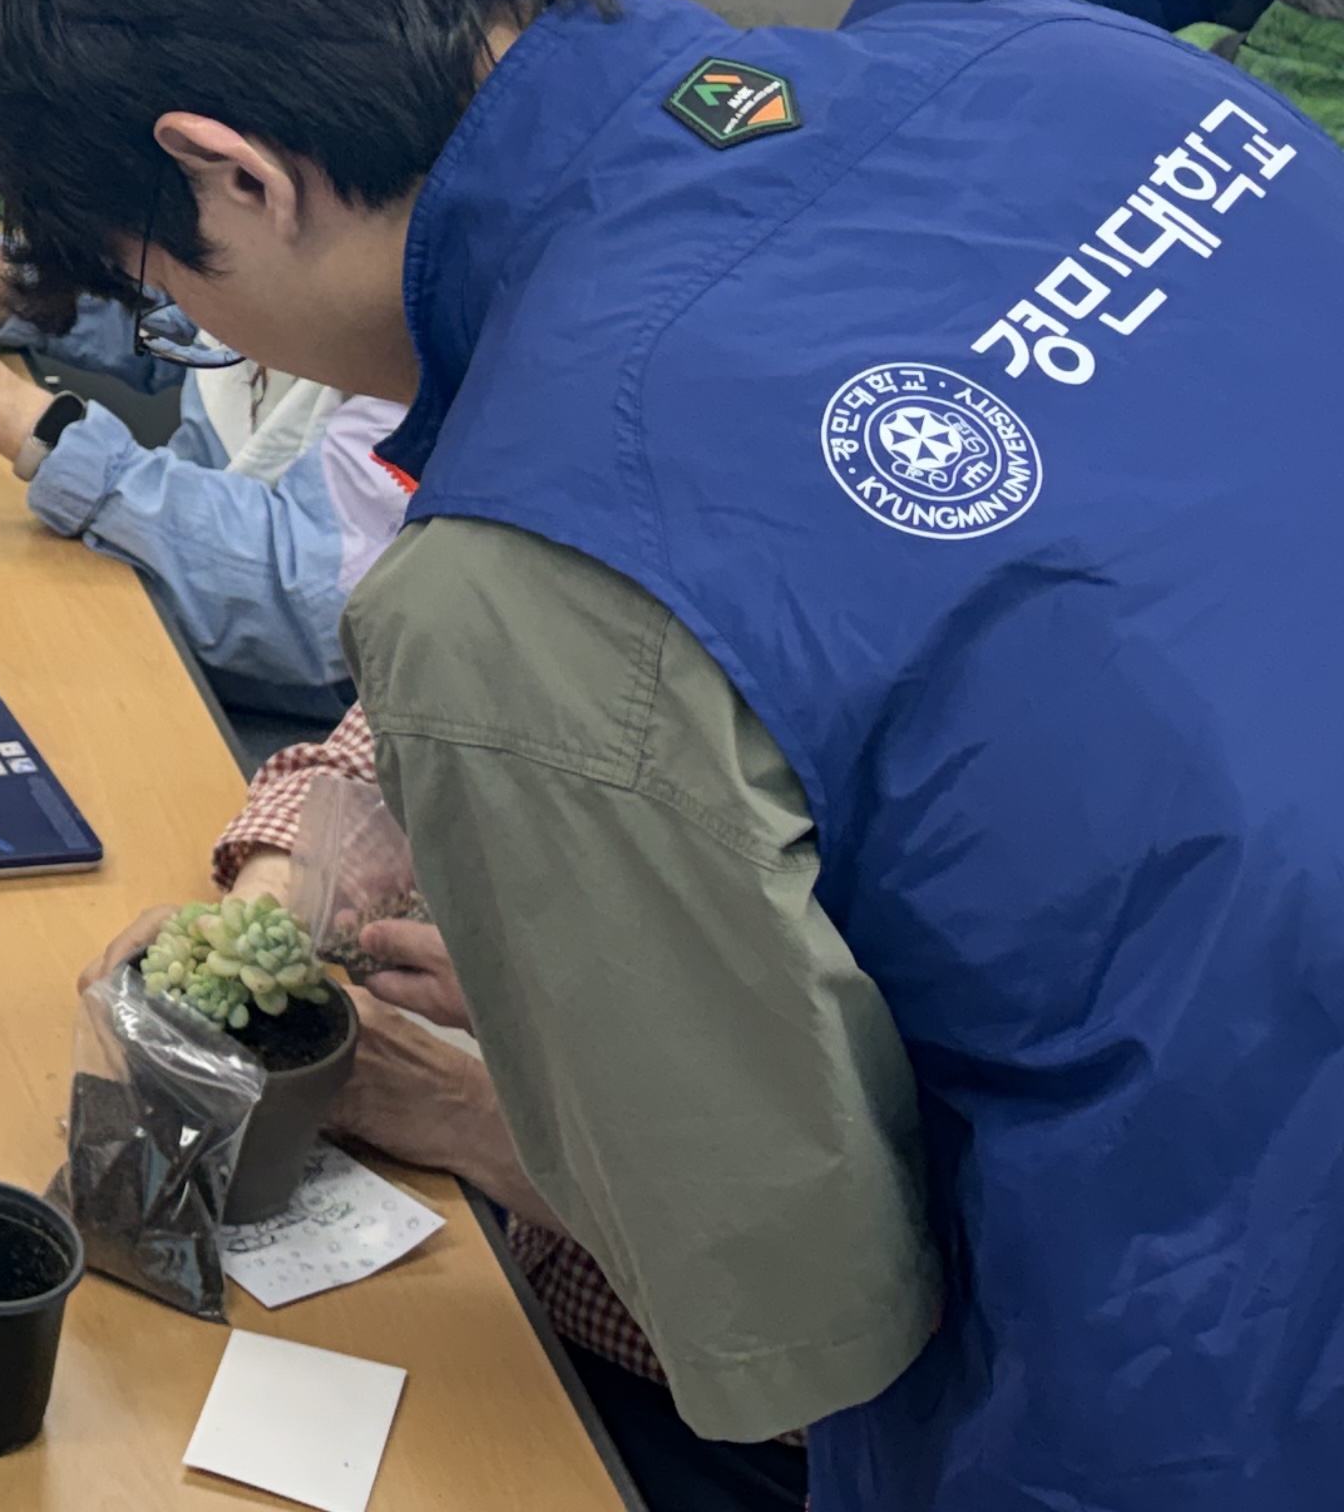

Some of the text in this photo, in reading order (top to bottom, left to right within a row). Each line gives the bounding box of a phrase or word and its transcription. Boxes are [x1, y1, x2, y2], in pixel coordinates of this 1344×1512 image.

[970, 99, 1296, 385] 경민대학교
[829, 368, 928, 462] 경민대학교
[856, 385, 1030, 530] KYUNGMIN UNIVERSITY
